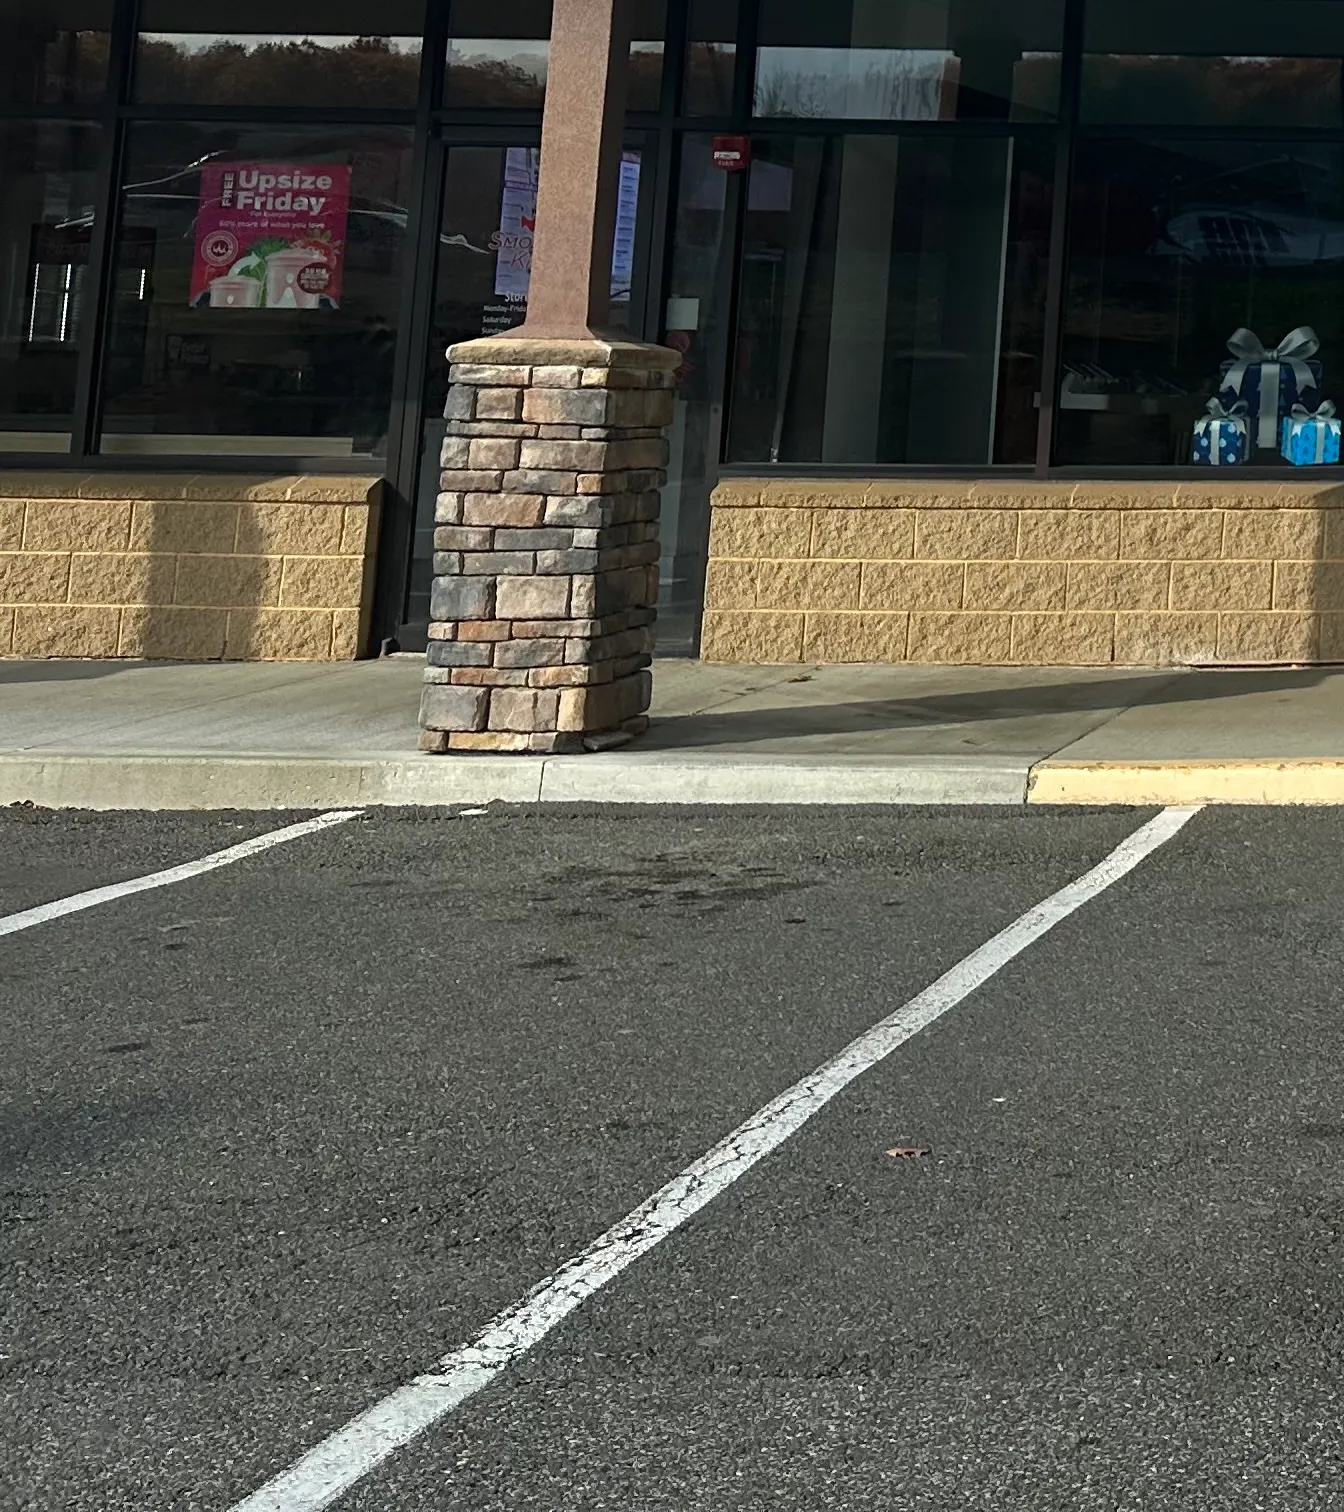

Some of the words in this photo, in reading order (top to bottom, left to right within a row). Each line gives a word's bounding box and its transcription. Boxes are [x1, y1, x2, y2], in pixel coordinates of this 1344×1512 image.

[221, 172, 235, 207] FREE
[238, 170, 333, 193] Upsize
[236, 191, 326, 216] Friday
